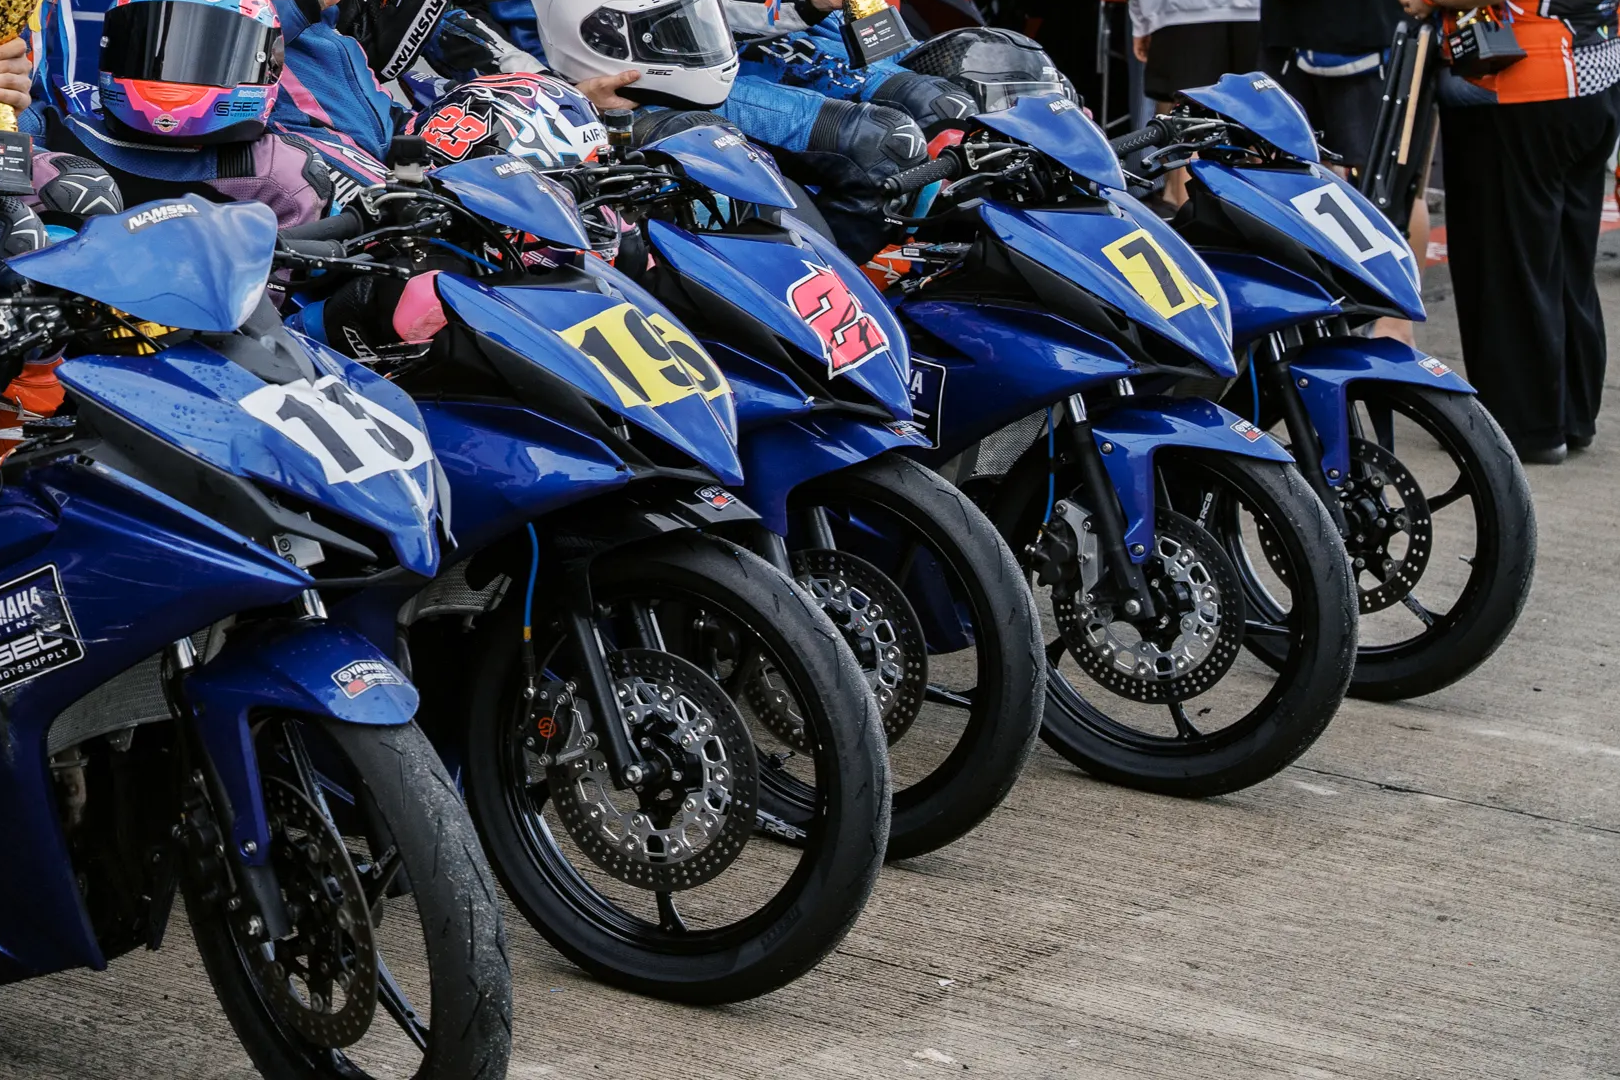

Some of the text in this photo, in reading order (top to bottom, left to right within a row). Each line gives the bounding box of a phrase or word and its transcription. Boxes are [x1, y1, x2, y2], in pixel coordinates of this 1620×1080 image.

[646, 69, 674, 77] SEC
[231, 101, 261, 112] SEC
[127, 204, 198, 230] NAMSSA
[1314, 191, 1373, 253] 1
[1120, 237, 1182, 309] 7
[578, 307, 721, 403] 19
[1200, 492, 1213, 521] RCB
